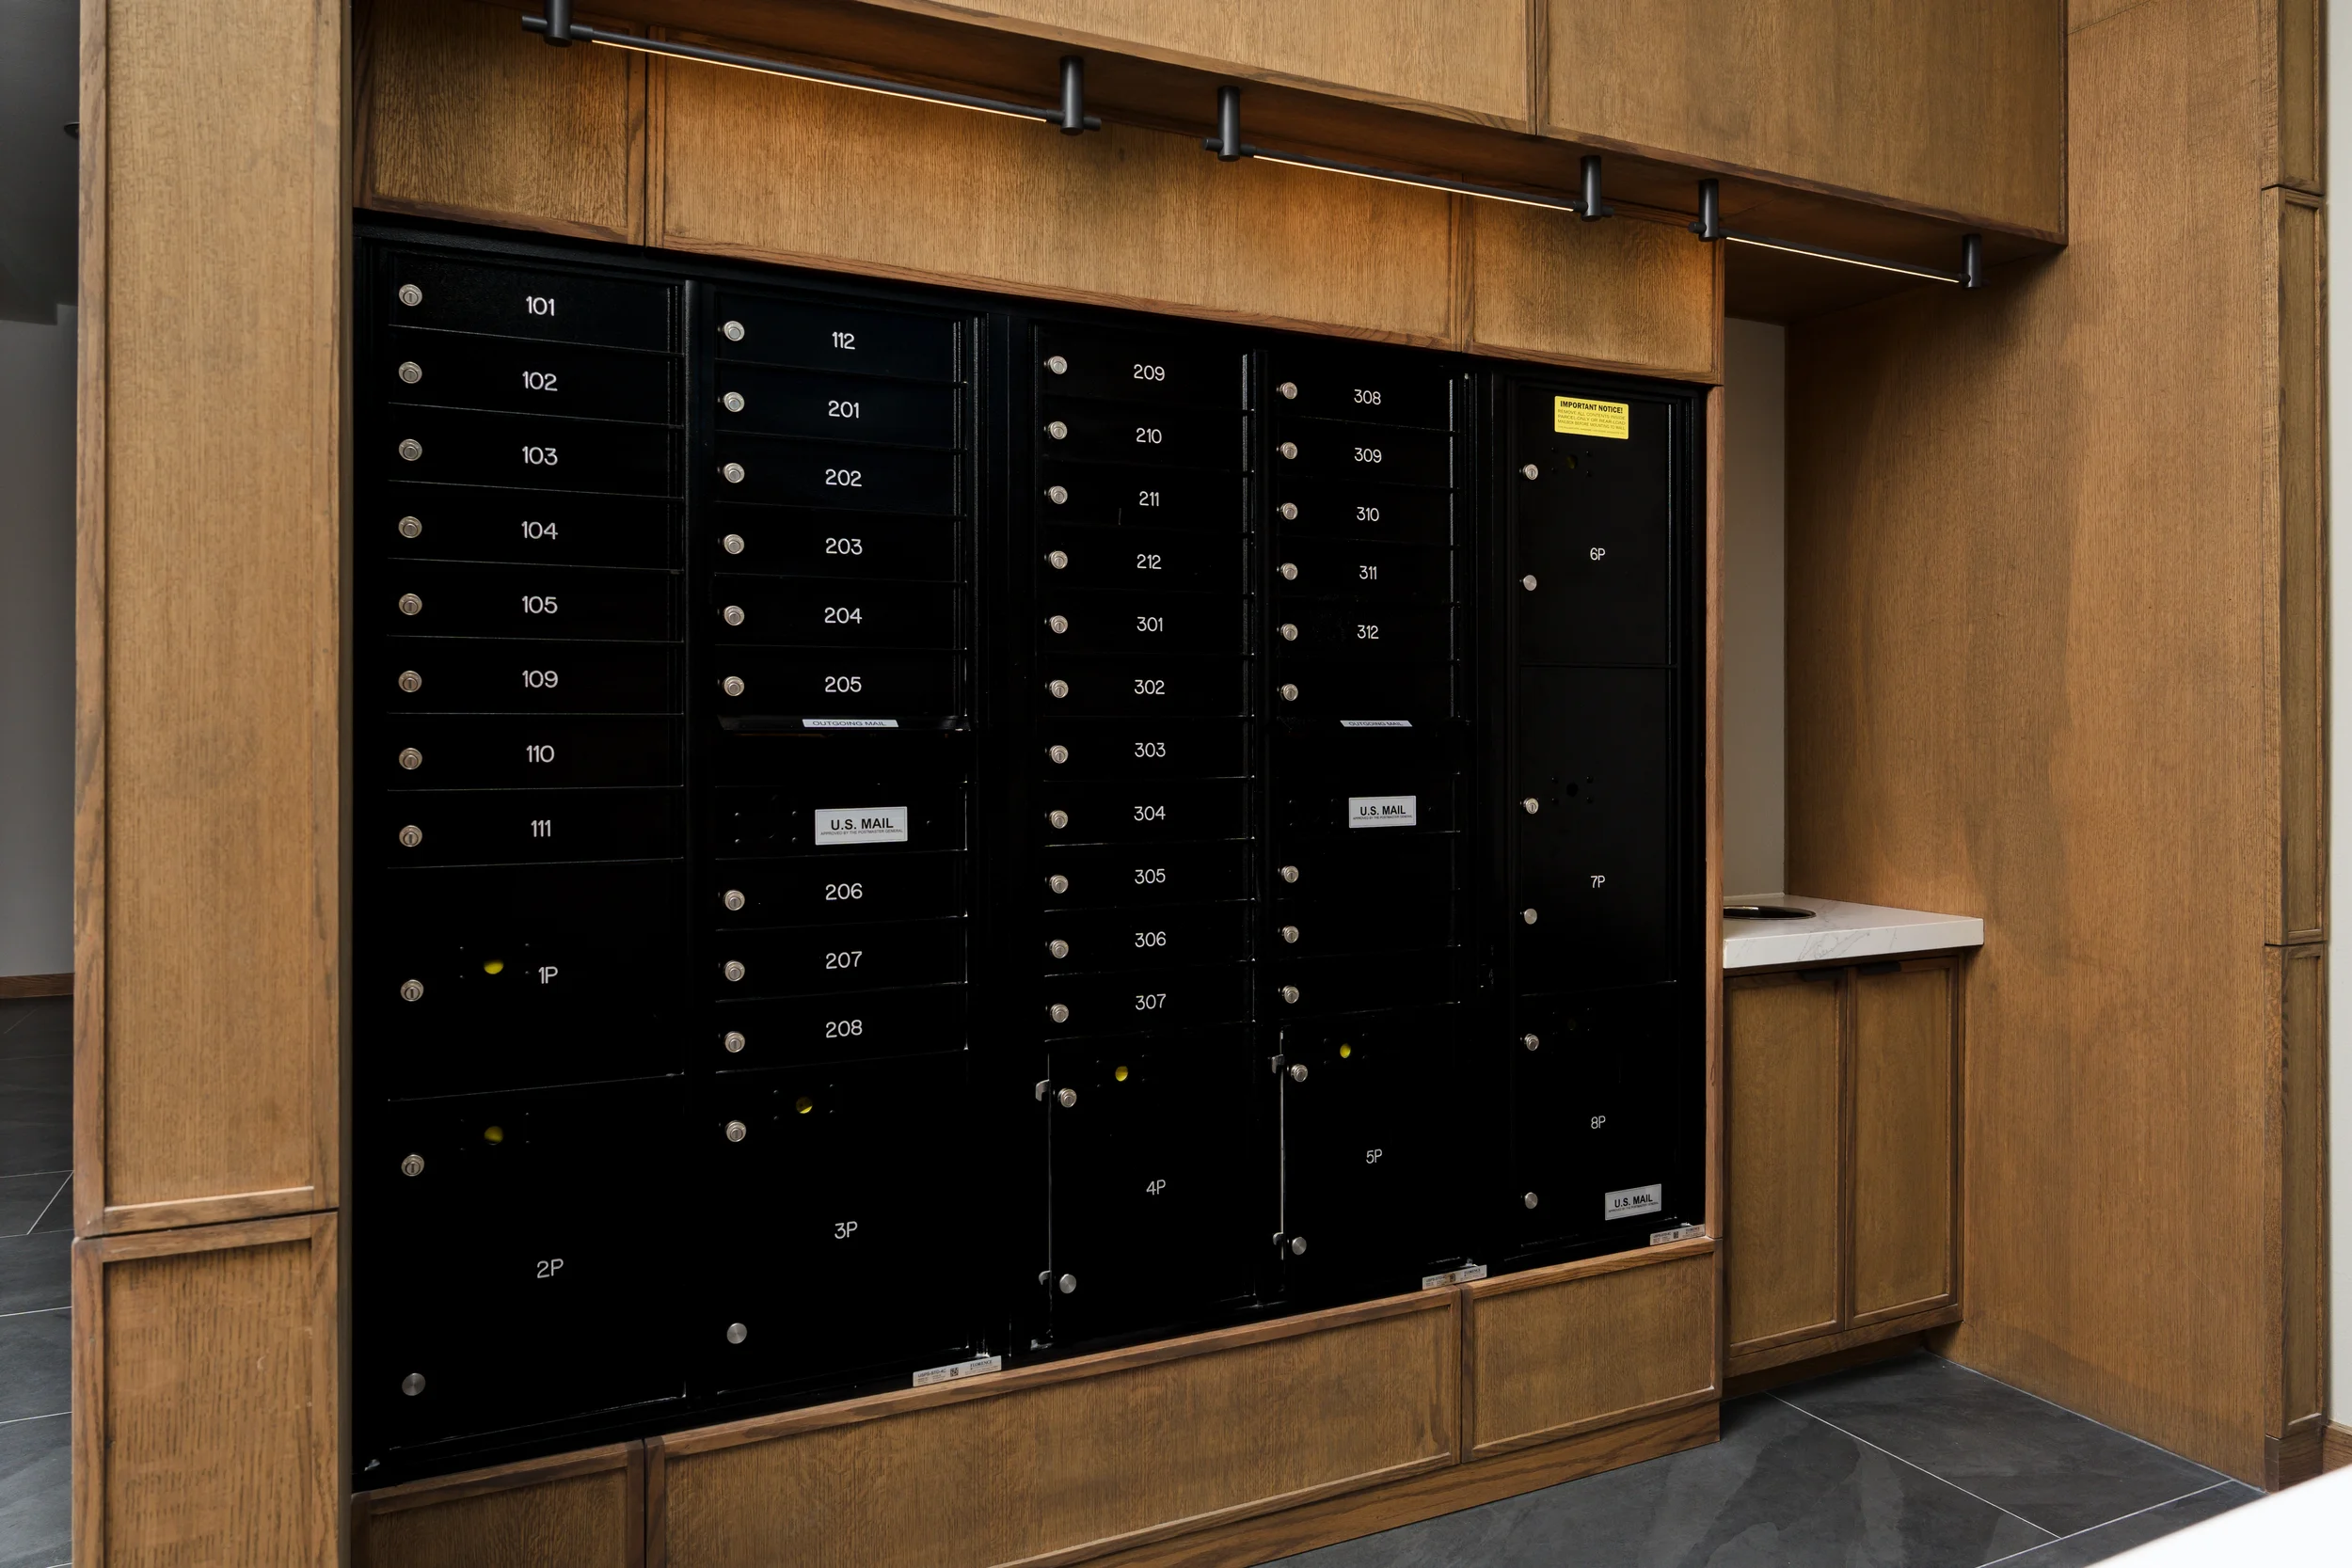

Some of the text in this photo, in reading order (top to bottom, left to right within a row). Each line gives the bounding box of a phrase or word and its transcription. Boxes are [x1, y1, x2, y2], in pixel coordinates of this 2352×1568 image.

[525, 295, 555, 317] 101
[832, 331, 856, 350] 112
[521, 371, 558, 392] 102
[1133, 363, 1166, 382] 209
[1353, 388, 1382, 405] 308
[828, 400, 860, 420] 201
[1560, 401, 1624, 414] IMPORTANT NOTICE!
[1136, 427, 1163, 444] 210
[521, 446, 558, 466] 103
[1354, 447, 1382, 464] 309
[825, 468, 863, 487] 202
[1138, 490, 1160, 507] 211
[1356, 506, 1380, 522] 310
[521, 520, 559, 540] 104
[825, 537, 863, 556] 203
[1589, 546, 1606, 562] 6P
[1136, 553, 1162, 570] 212
[1359, 564, 1377, 580] 311
[521, 595, 558, 614] 105
[824, 607, 863, 625] 204
[1136, 616, 1163, 632] 301
[1357, 625, 1379, 640] 312
[521, 670, 559, 689] 109
[824, 675, 863, 693] 205
[1134, 679, 1166, 695] 302
[526, 744, 555, 763] 110
[1134, 742, 1167, 758] 303
[1134, 805, 1167, 822] 304
[1360, 805, 1406, 816] U.S. MAIL
[531, 819, 551, 838] 111
[831, 817, 894, 831] U.S. MAIL
[1134, 868, 1166, 885] 305
[1590, 875, 1606, 889] 7P
[825, 882, 863, 901] 206
[1135, 930, 1167, 948] 306
[825, 950, 863, 970] 207
[536, 966, 559, 985] 1P
[1135, 992, 1167, 1011] 307
[825, 1019, 863, 1038] 208
[1590, 1115, 1606, 1130] 8P
[1365, 1148, 1383, 1164] 5P
[1146, 1179, 1167, 1196] 4P
[1614, 1197, 1630, 1208] U.S.
[1633, 1194, 1653, 1205] MAIL
[834, 1220, 858, 1240] 3P
[536, 1258, 564, 1279] 2P
